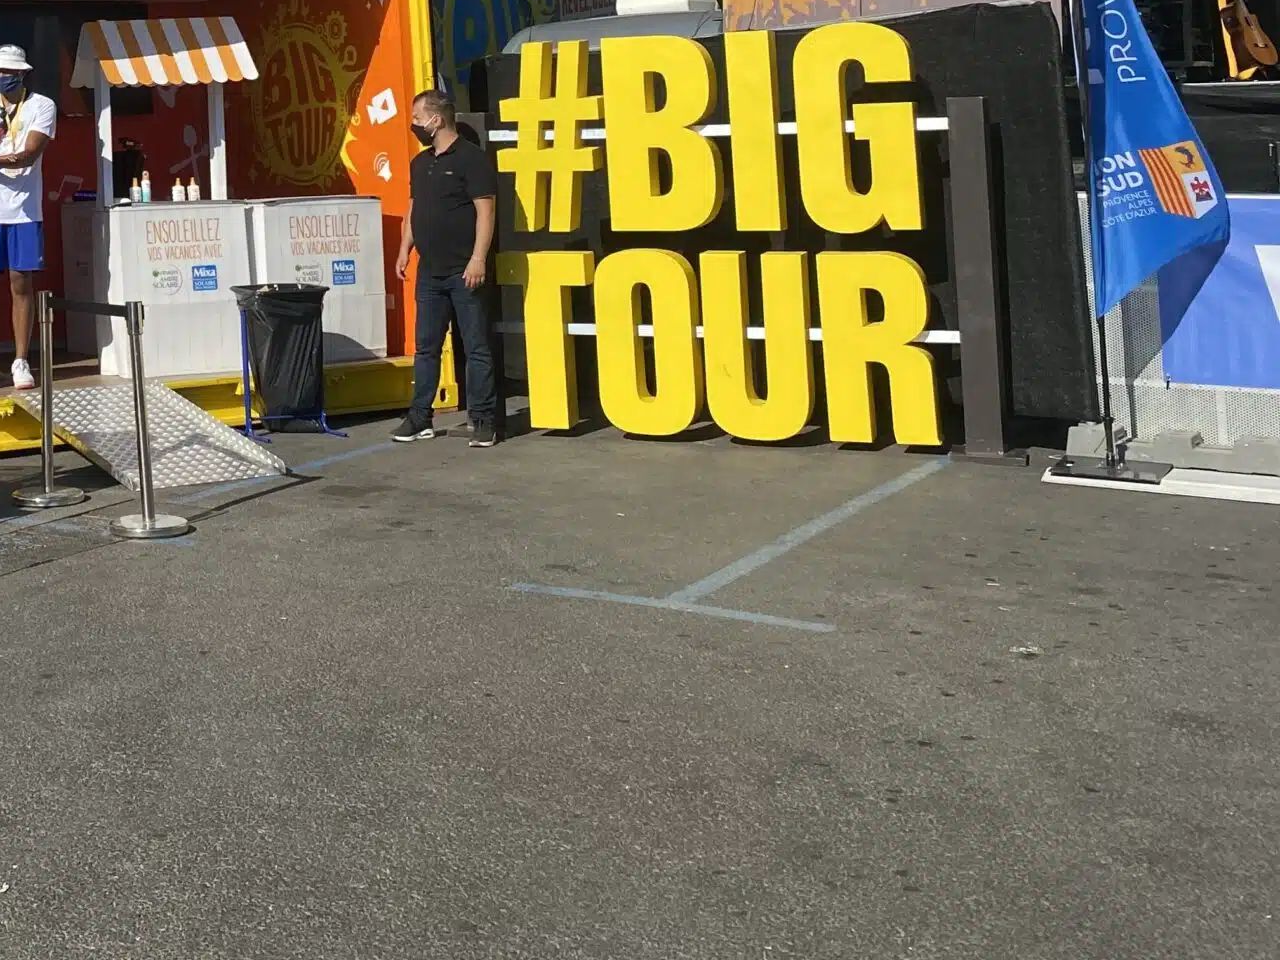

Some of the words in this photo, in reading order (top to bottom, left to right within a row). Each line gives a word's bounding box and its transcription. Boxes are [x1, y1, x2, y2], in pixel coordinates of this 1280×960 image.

[262, 40, 337, 118] BIG
[264, 106, 337, 167] TOUR
[497, 22, 924, 234] #BIG
[1096, 171, 1144, 197] SUD
[1103, 190, 1151, 208] PROVENCE
[1128, 198, 1154, 210] ALPES
[1125, 206, 1158, 220] D'AZUR
[145, 217, 221, 244] ENSOLEILLEZ
[288, 213, 360, 240] ENSOLEILLEZ
[147, 246, 162, 261] VOS
[164, 244, 201, 260] VACANCES
[204, 243, 224, 258] AVEC
[290, 242, 305, 256] VOS
[306, 240, 342, 256] VACANCES
[343, 238, 361, 253] AVEC
[193, 267, 216, 278] Mixa
[333, 262, 355, 273] Mixa
[497, 248, 942, 446] TOUR
